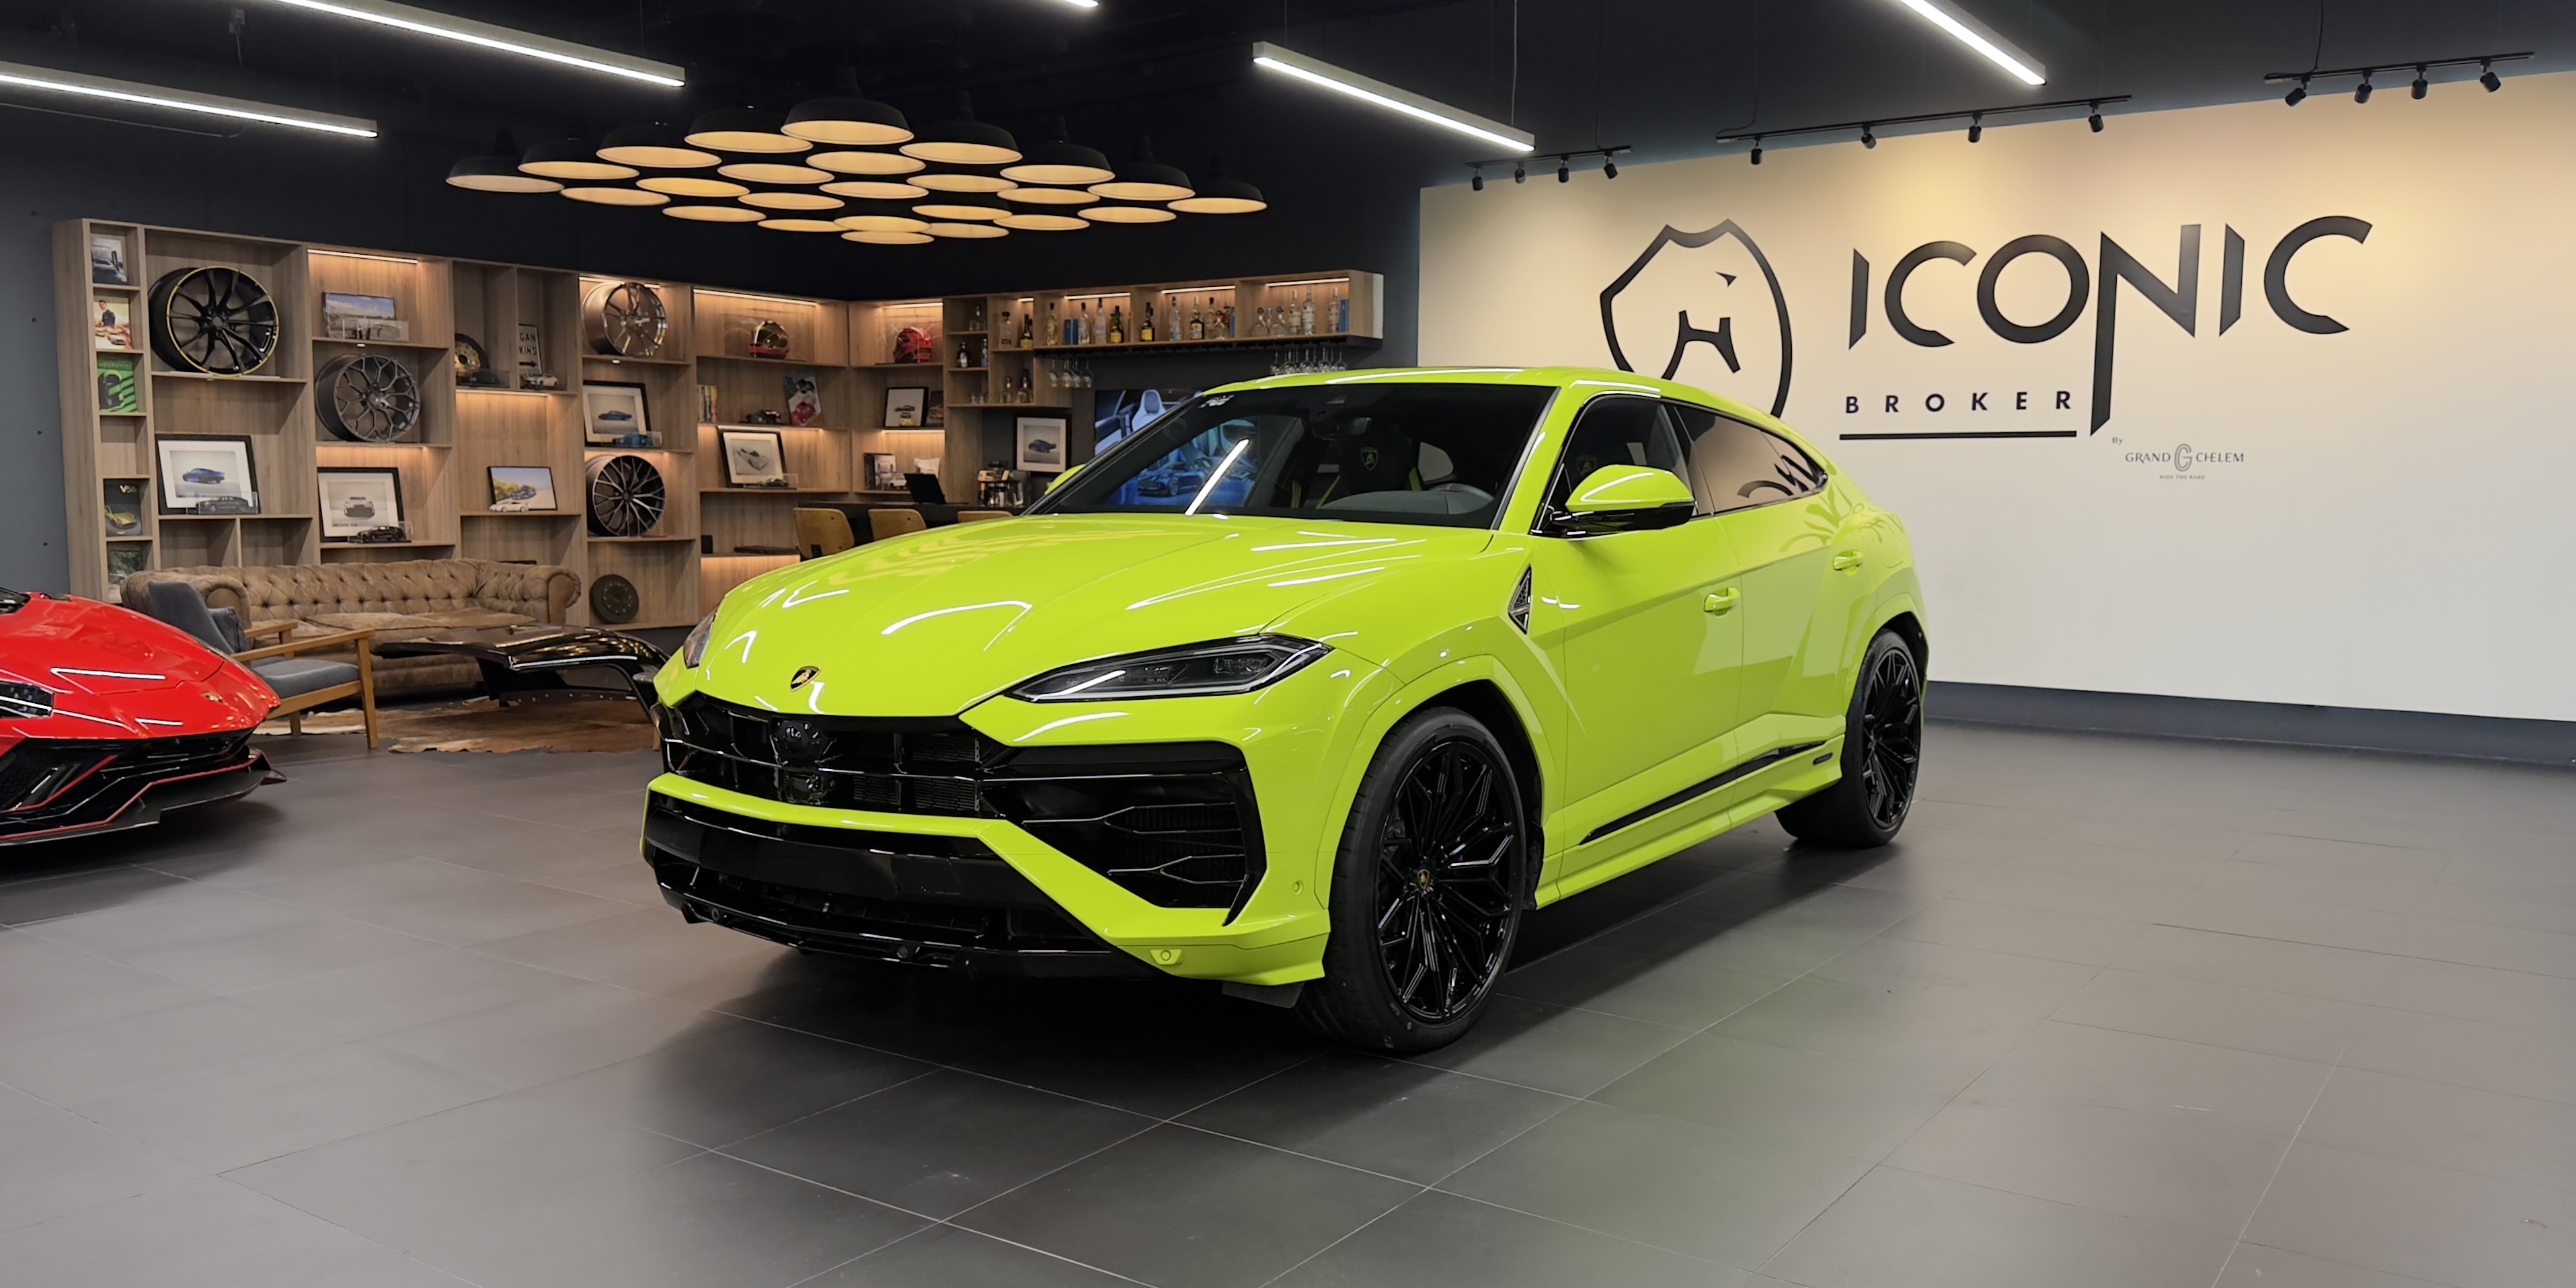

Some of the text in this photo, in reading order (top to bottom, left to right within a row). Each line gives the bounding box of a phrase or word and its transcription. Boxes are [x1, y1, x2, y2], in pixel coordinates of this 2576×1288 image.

[1849, 216, 2373, 436] ICONIC
[1846, 391, 2070, 413] BROKER
[2111, 436, 2123, 446] By
[2125, 452, 2171, 464] GRAND
[2196, 452, 2245, 462] CHELEM
